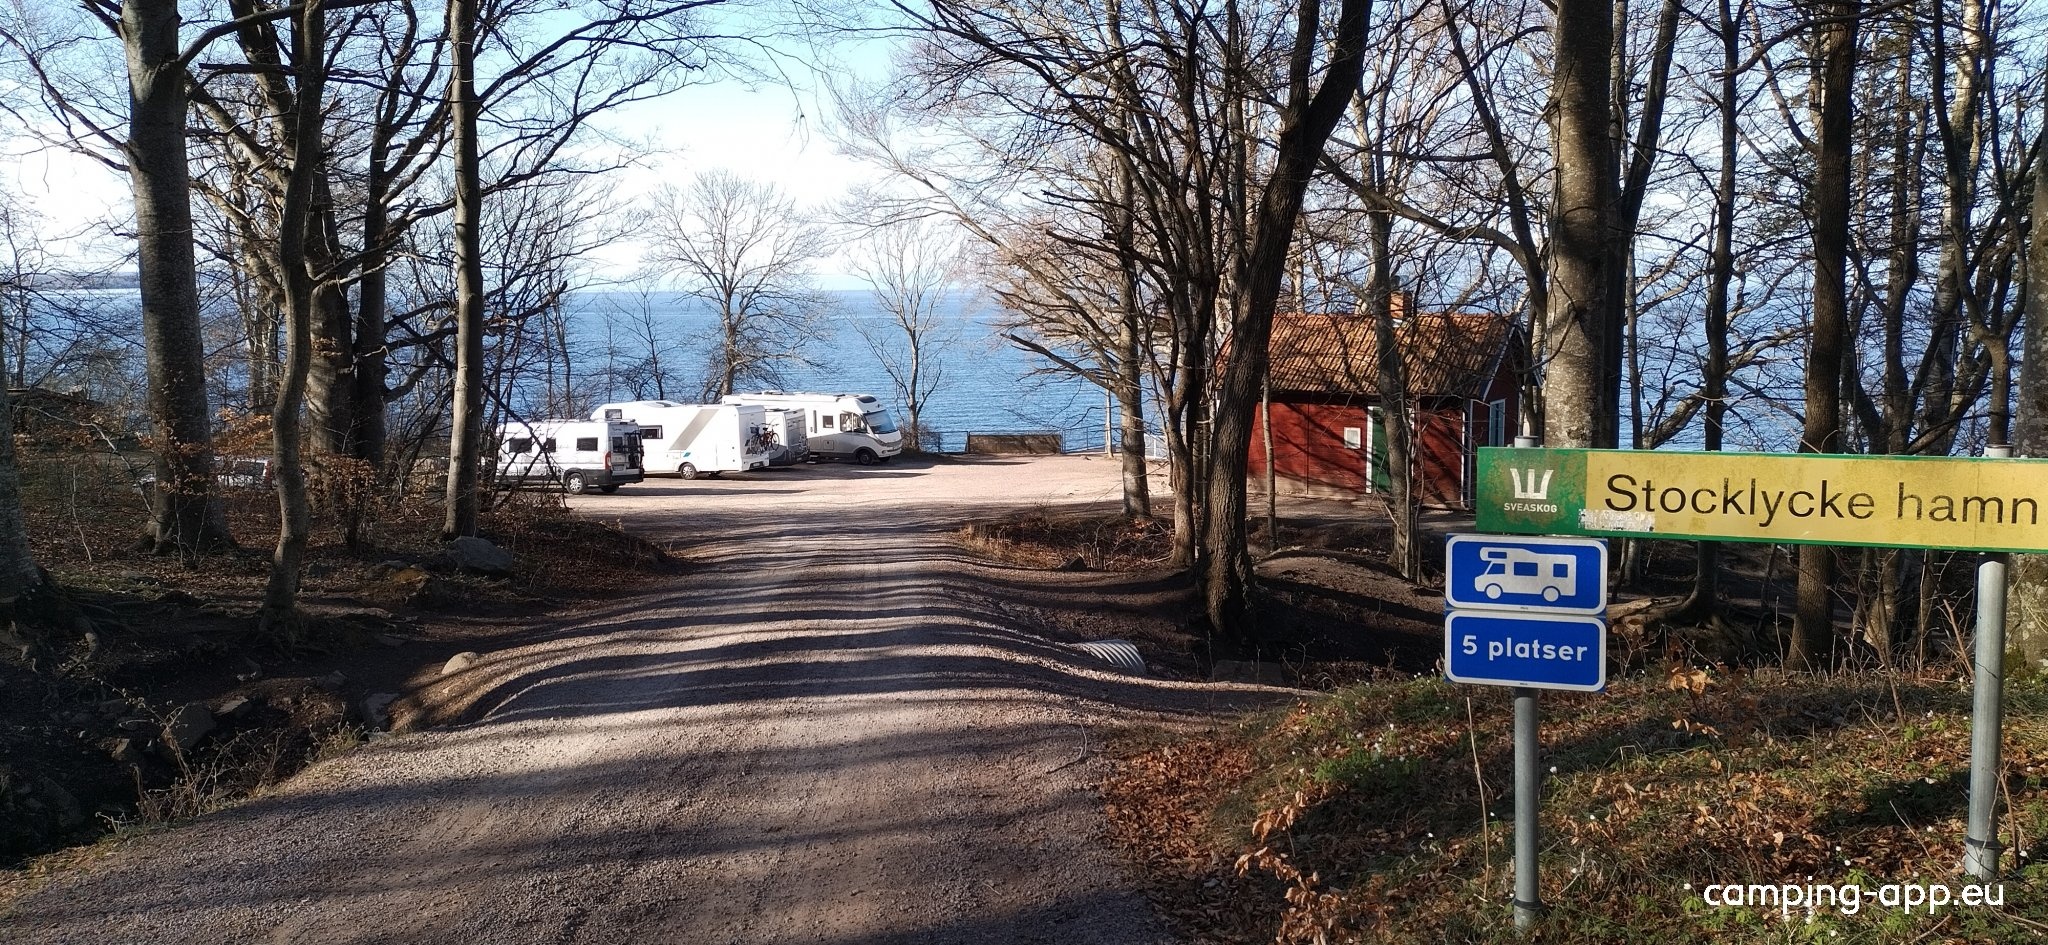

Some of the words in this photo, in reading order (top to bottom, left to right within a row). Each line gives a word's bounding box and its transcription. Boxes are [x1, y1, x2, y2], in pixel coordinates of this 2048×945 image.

[1503, 502, 1558, 513] SVEASKOG
[1604, 474, 1875, 528] Stocklycke
[1897, 481, 2038, 525] hamn
[1462, 634, 1478, 655] 5
[1488, 637, 1588, 662] platser
